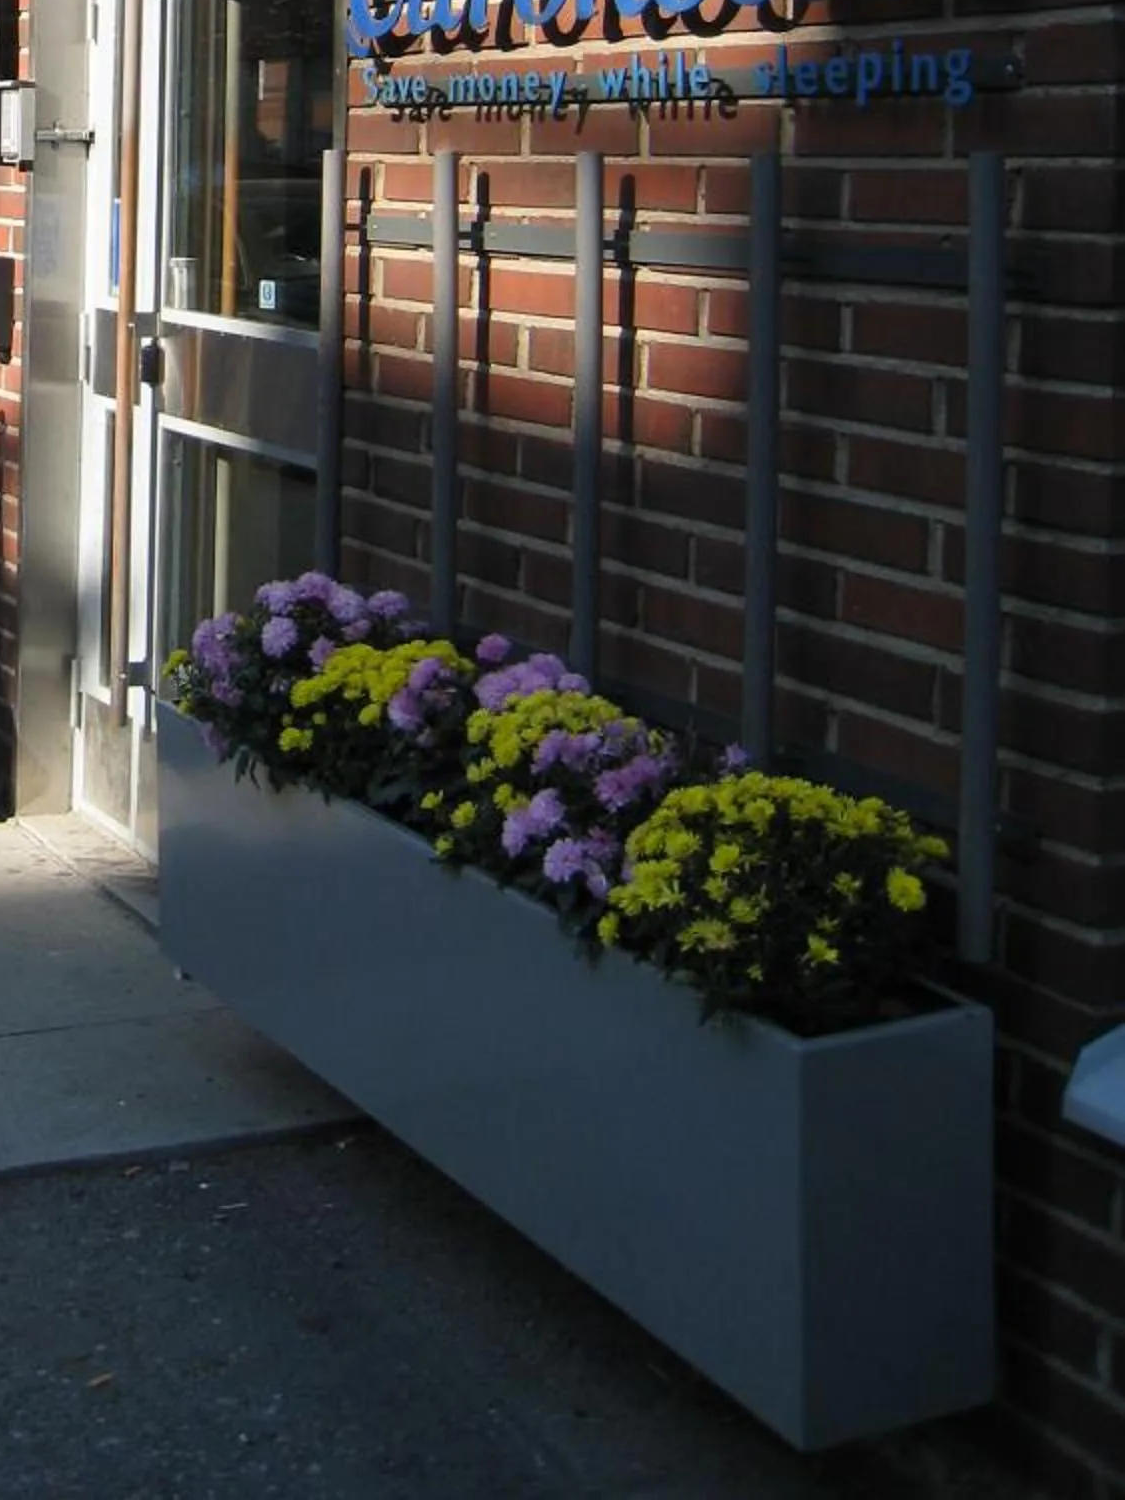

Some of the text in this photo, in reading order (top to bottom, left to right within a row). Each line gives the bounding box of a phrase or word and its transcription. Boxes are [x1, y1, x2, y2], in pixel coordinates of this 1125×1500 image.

[361, 34, 974, 115] Save money while sleeping
